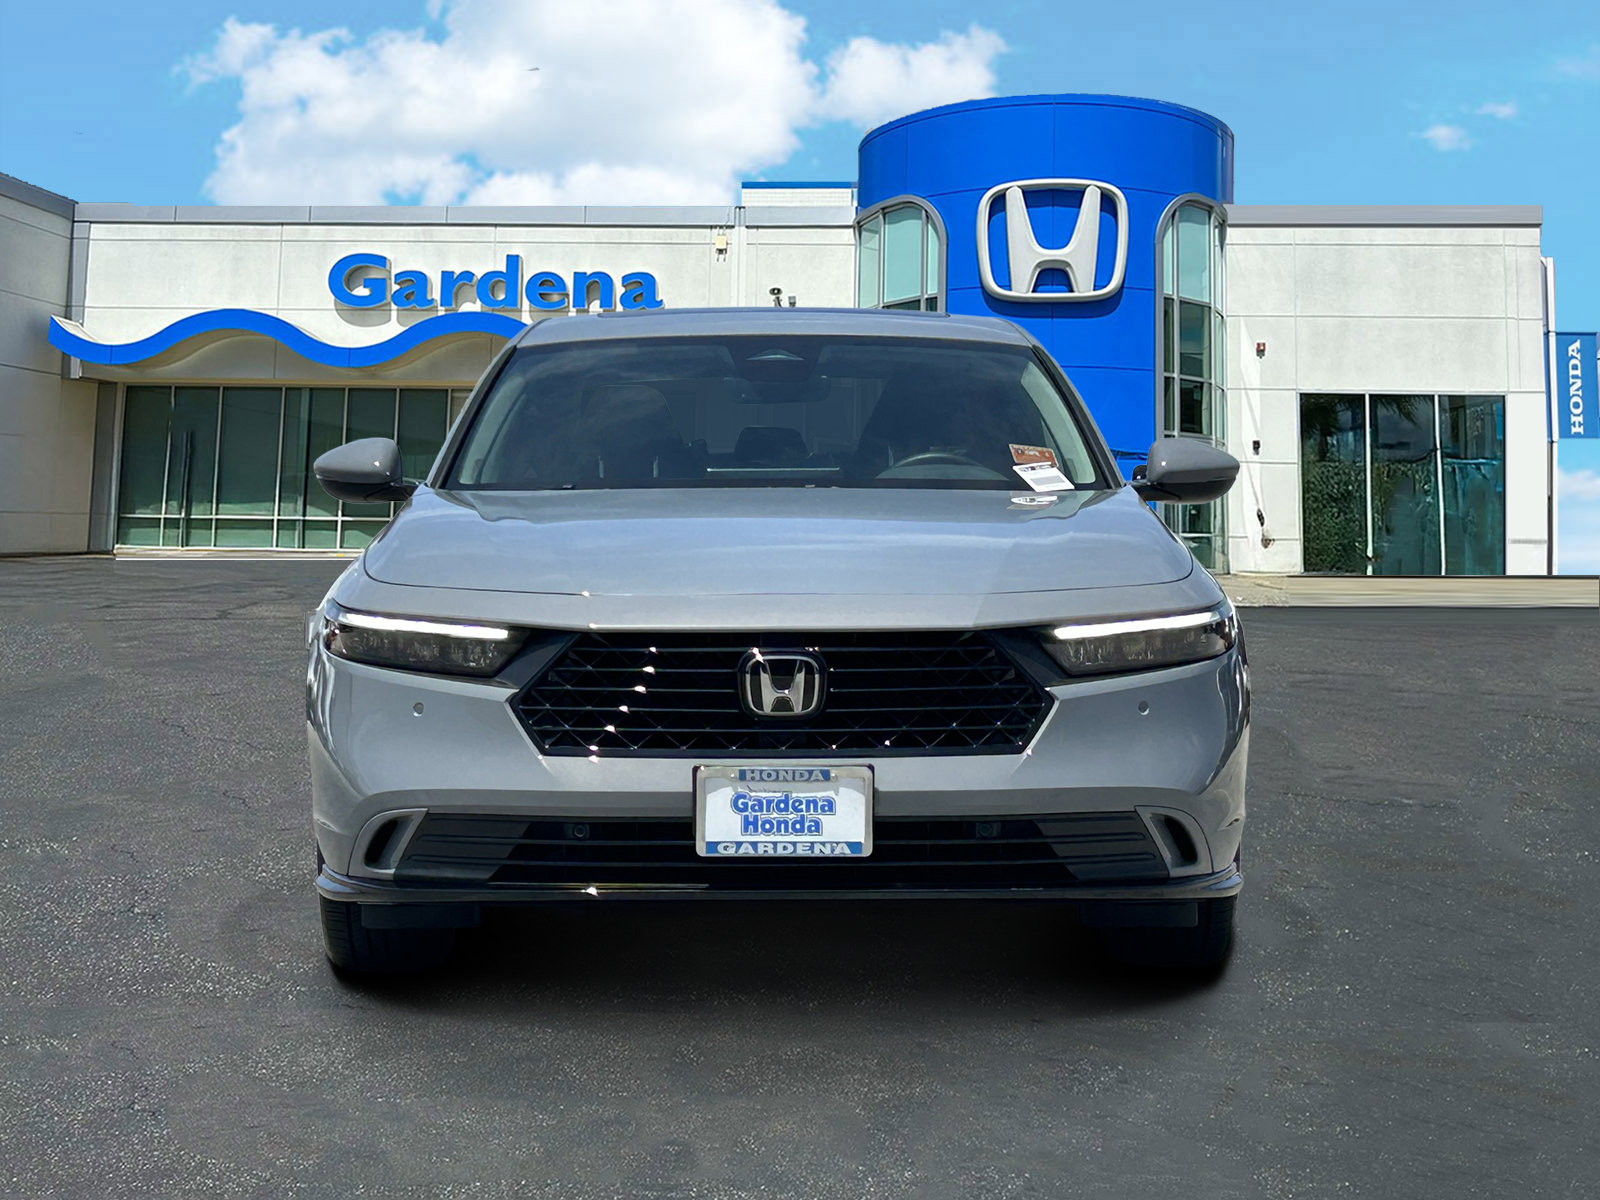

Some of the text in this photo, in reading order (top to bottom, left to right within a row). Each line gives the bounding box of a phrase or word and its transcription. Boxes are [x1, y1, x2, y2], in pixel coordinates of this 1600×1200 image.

[328, 253, 664, 310] Gardena
[1567, 339, 1584, 435] HONDA
[745, 770, 825, 782] HONDA
[731, 791, 836, 815] Gardena
[741, 814, 822, 836] Honda
[716, 842, 852, 855] GARDENA
